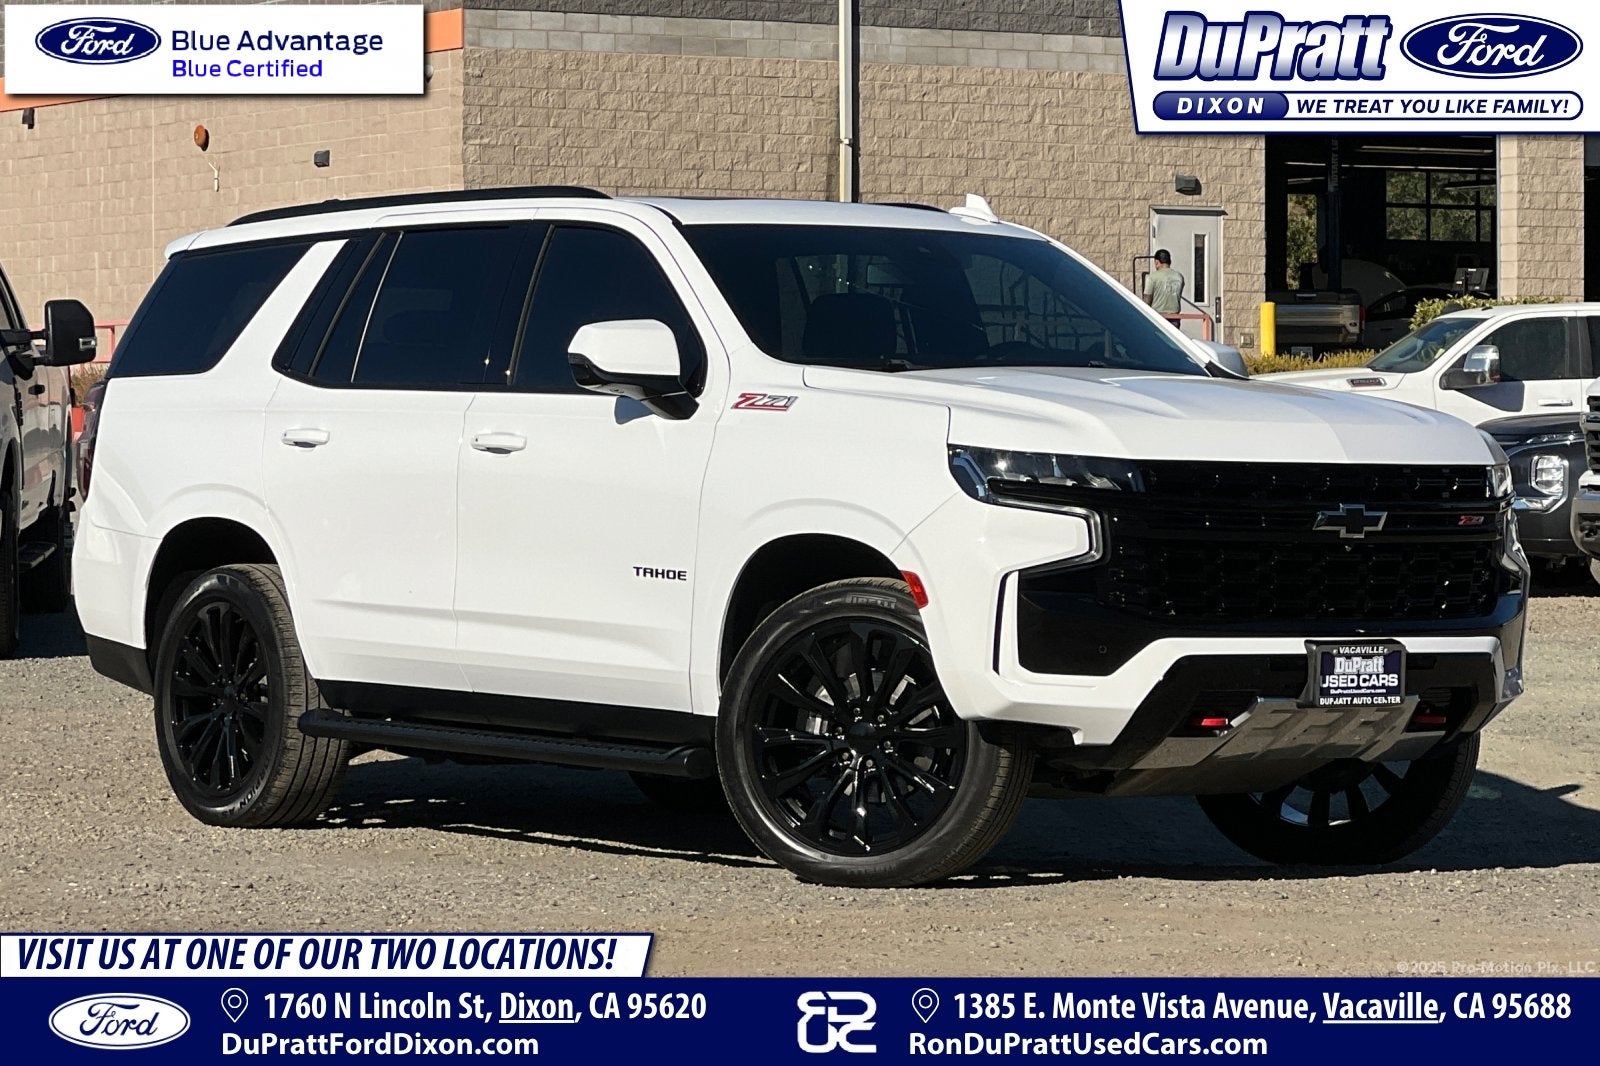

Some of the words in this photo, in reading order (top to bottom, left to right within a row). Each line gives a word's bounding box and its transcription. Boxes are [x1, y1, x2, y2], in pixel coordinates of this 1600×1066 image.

[731, 393, 798, 411] Z71
[633, 566, 687, 581] TAHOE
[1339, 646, 1384, 654] VACAVILLE
[1334, 656, 1384, 674] DuPratt
[1320, 674, 1357, 687] USED
[1359, 674, 1398, 687] CARS
